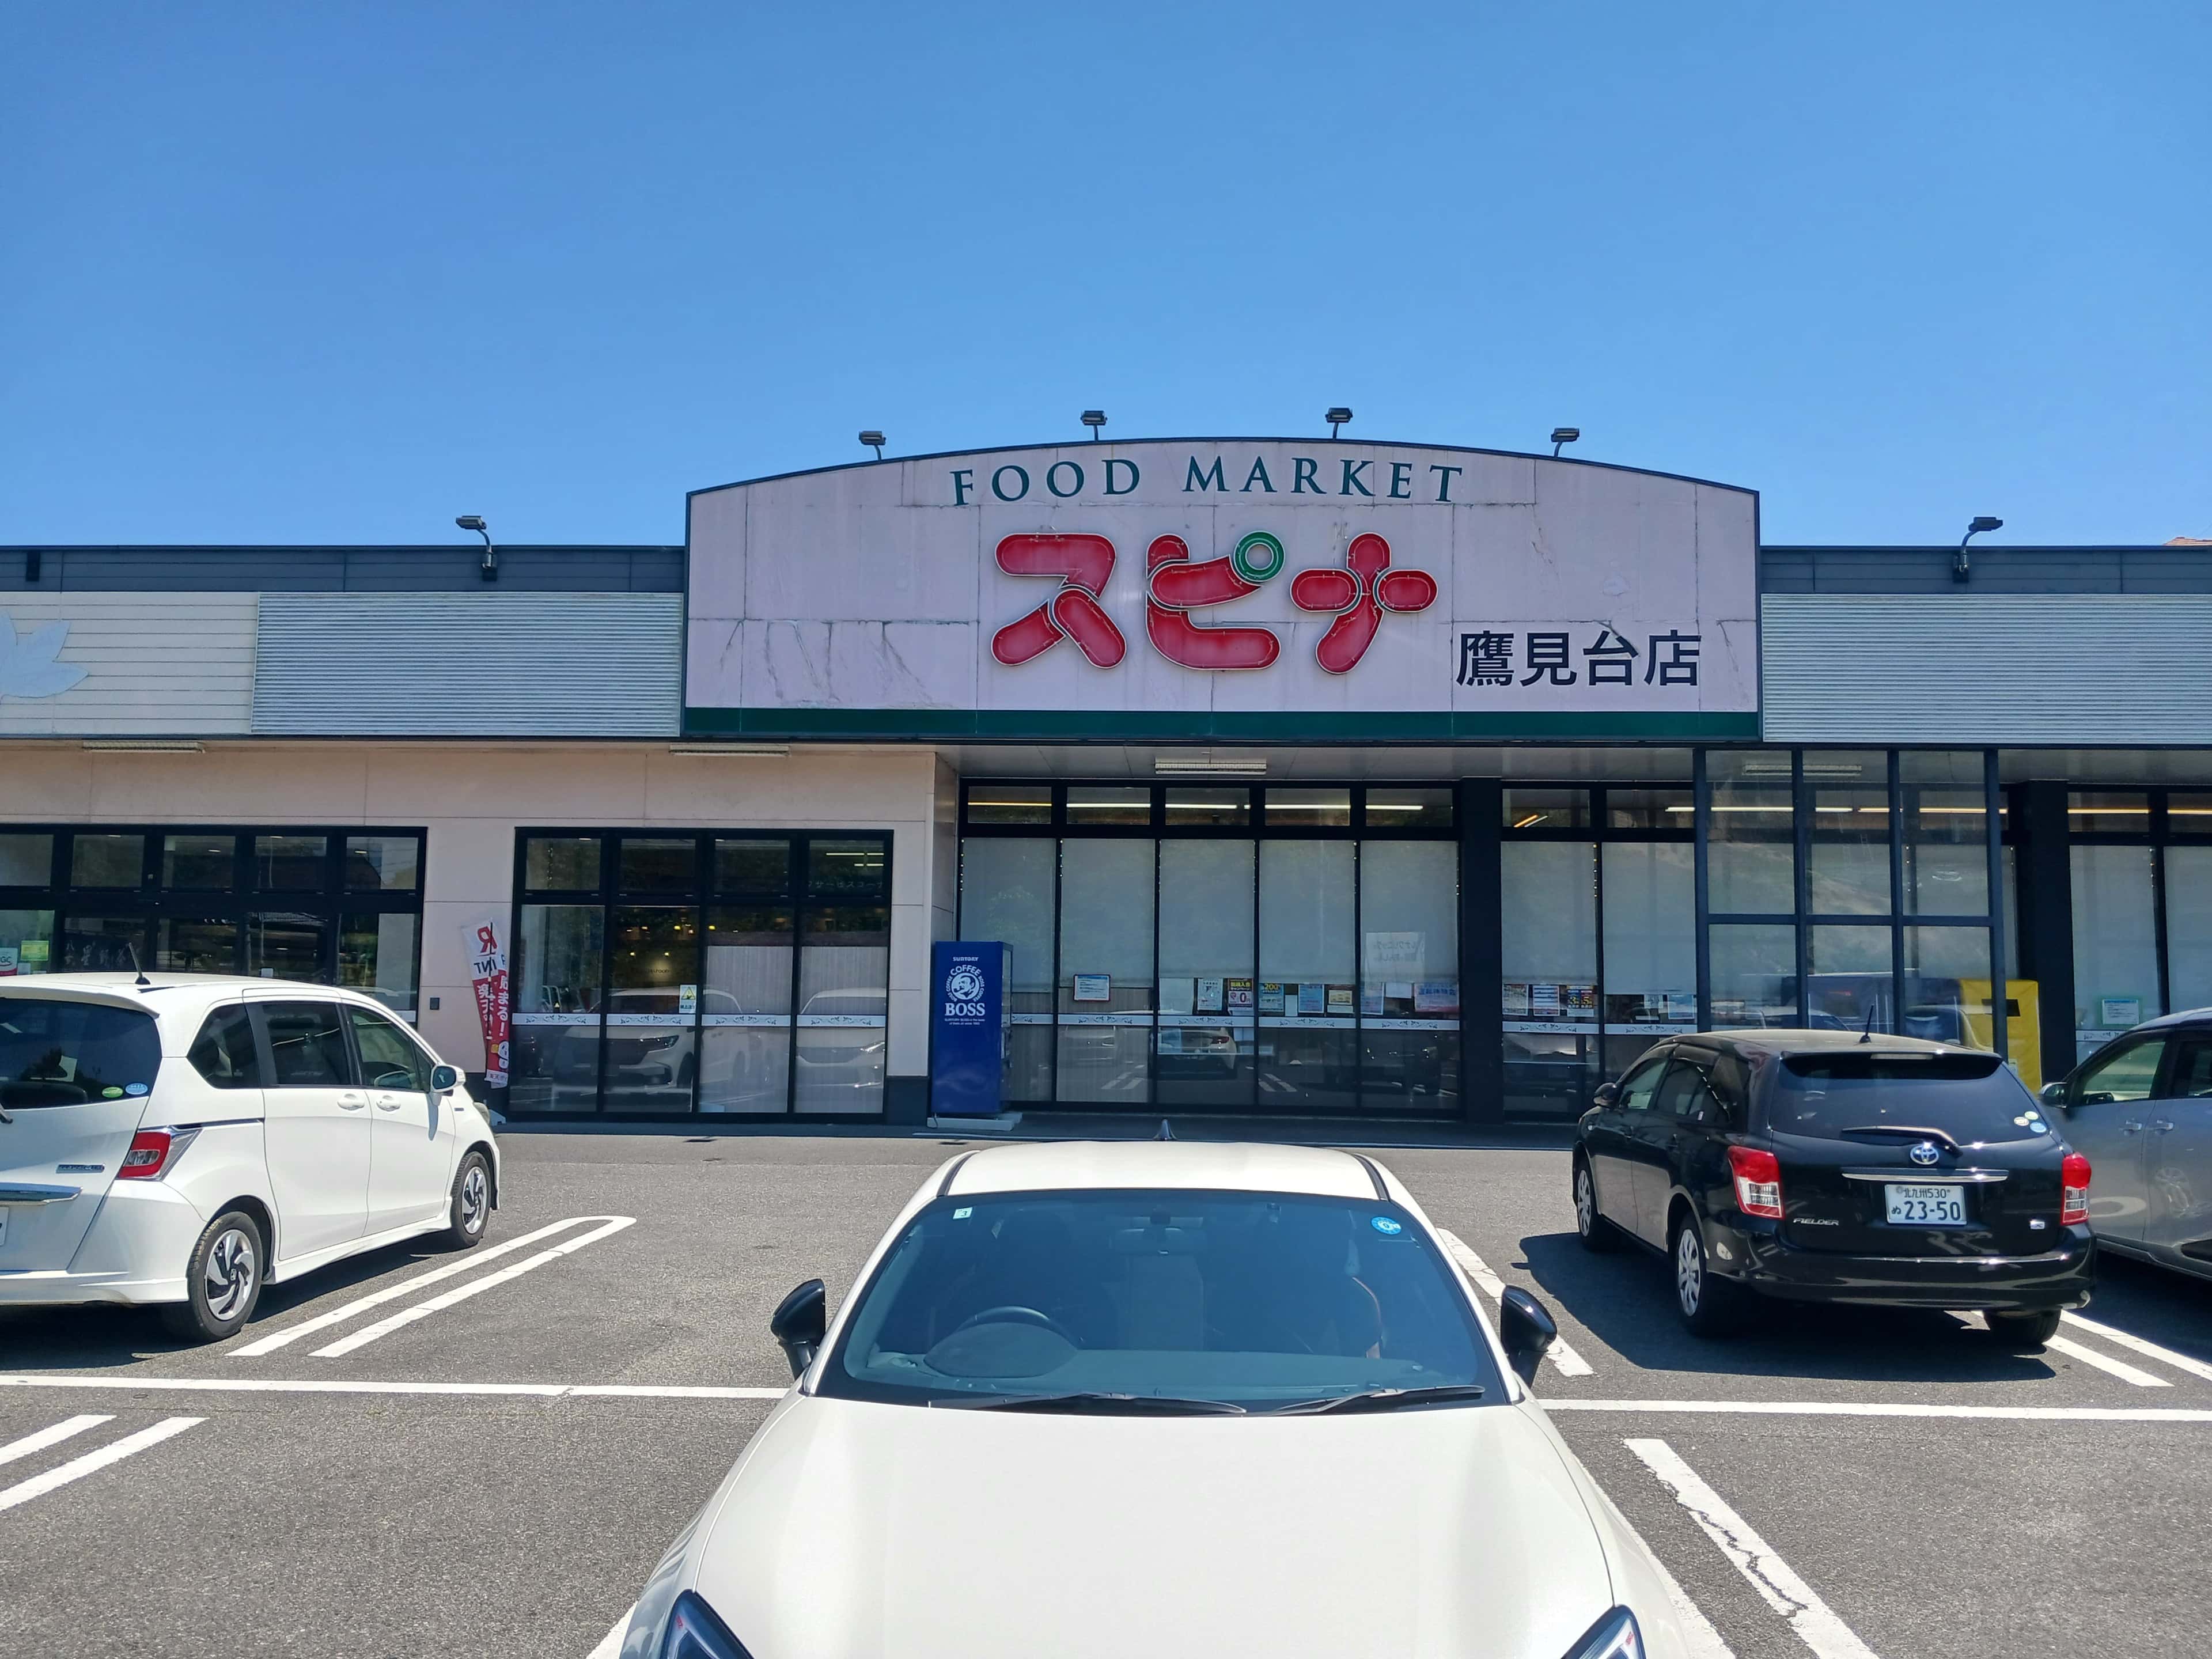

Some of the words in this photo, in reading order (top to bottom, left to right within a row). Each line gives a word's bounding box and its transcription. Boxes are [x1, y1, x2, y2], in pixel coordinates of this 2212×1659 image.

[950, 459, 1140, 506] FOOD
[1183, 456, 1462, 502] MARKET
[991, 531, 1438, 674] スピナ
[1456, 630, 1702, 687] 鷹見台店
[950, 964, 982, 976] COFFEE
[945, 1002, 985, 1016] BOSS
[1904, 1200, 1961, 1221] 23-50
